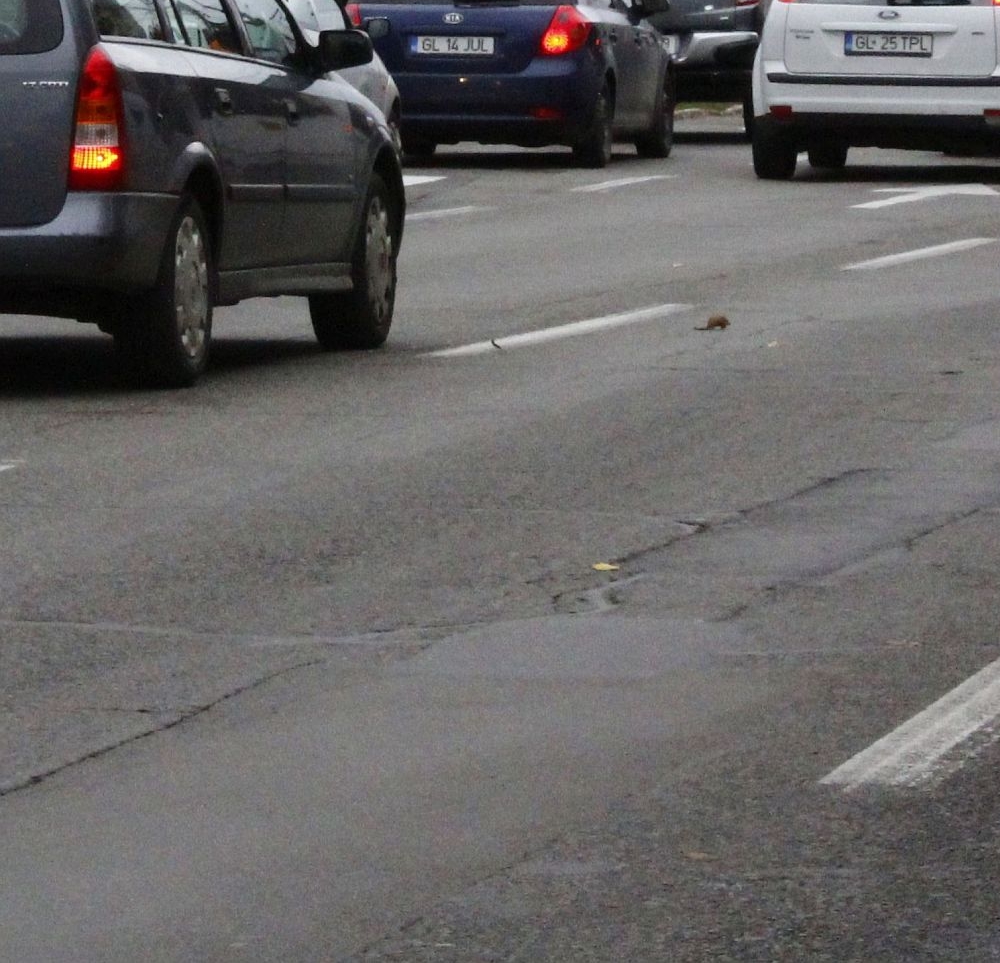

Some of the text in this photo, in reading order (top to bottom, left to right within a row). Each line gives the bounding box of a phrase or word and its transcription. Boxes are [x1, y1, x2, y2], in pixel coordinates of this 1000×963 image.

[422, 38, 488, 53] GL 14 JUL
[855, 36, 928, 52] GL 25 TPL
